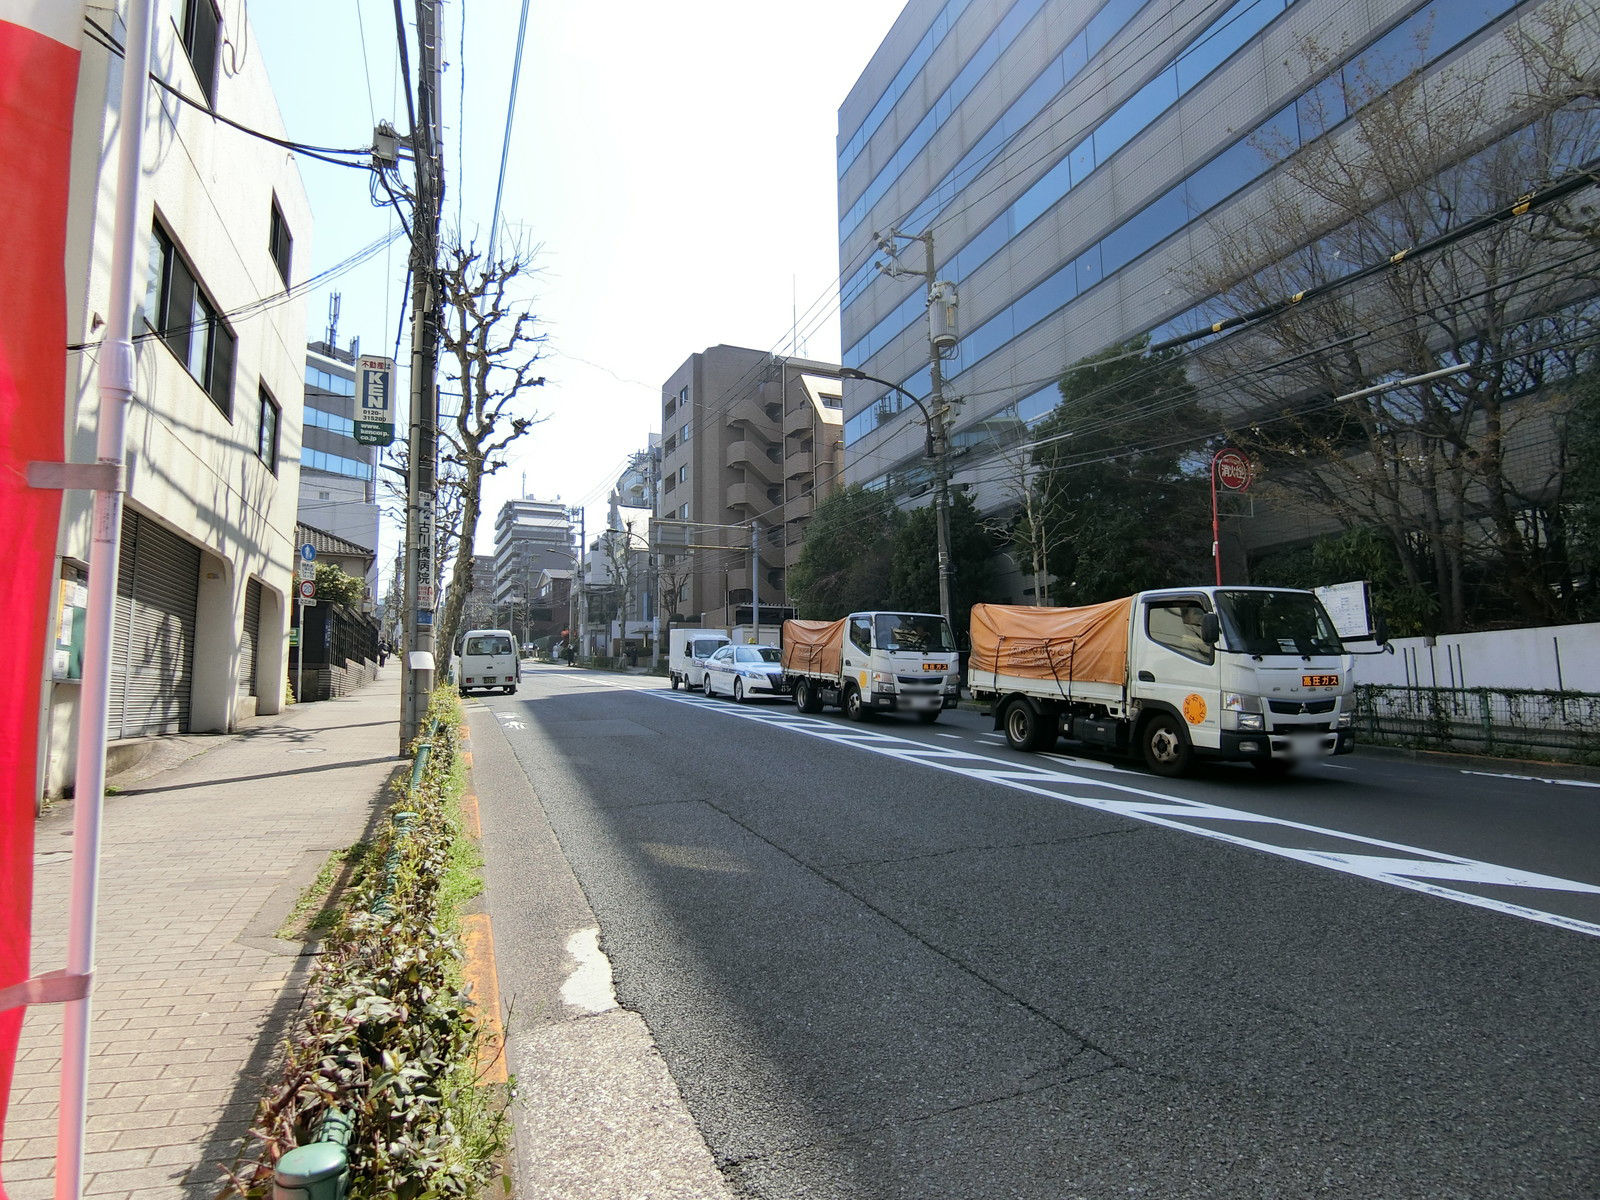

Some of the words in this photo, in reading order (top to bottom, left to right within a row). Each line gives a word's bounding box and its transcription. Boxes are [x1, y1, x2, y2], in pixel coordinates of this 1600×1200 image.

[362, 361, 391, 370] 不動産は
[368, 371, 384, 409] KEN
[360, 429, 389, 437] kencorp.
[1222, 464, 1245, 478] 消火栓
[304, 585, 311, 593] 20
[1304, 676, 1338, 686] 高圧ガス
